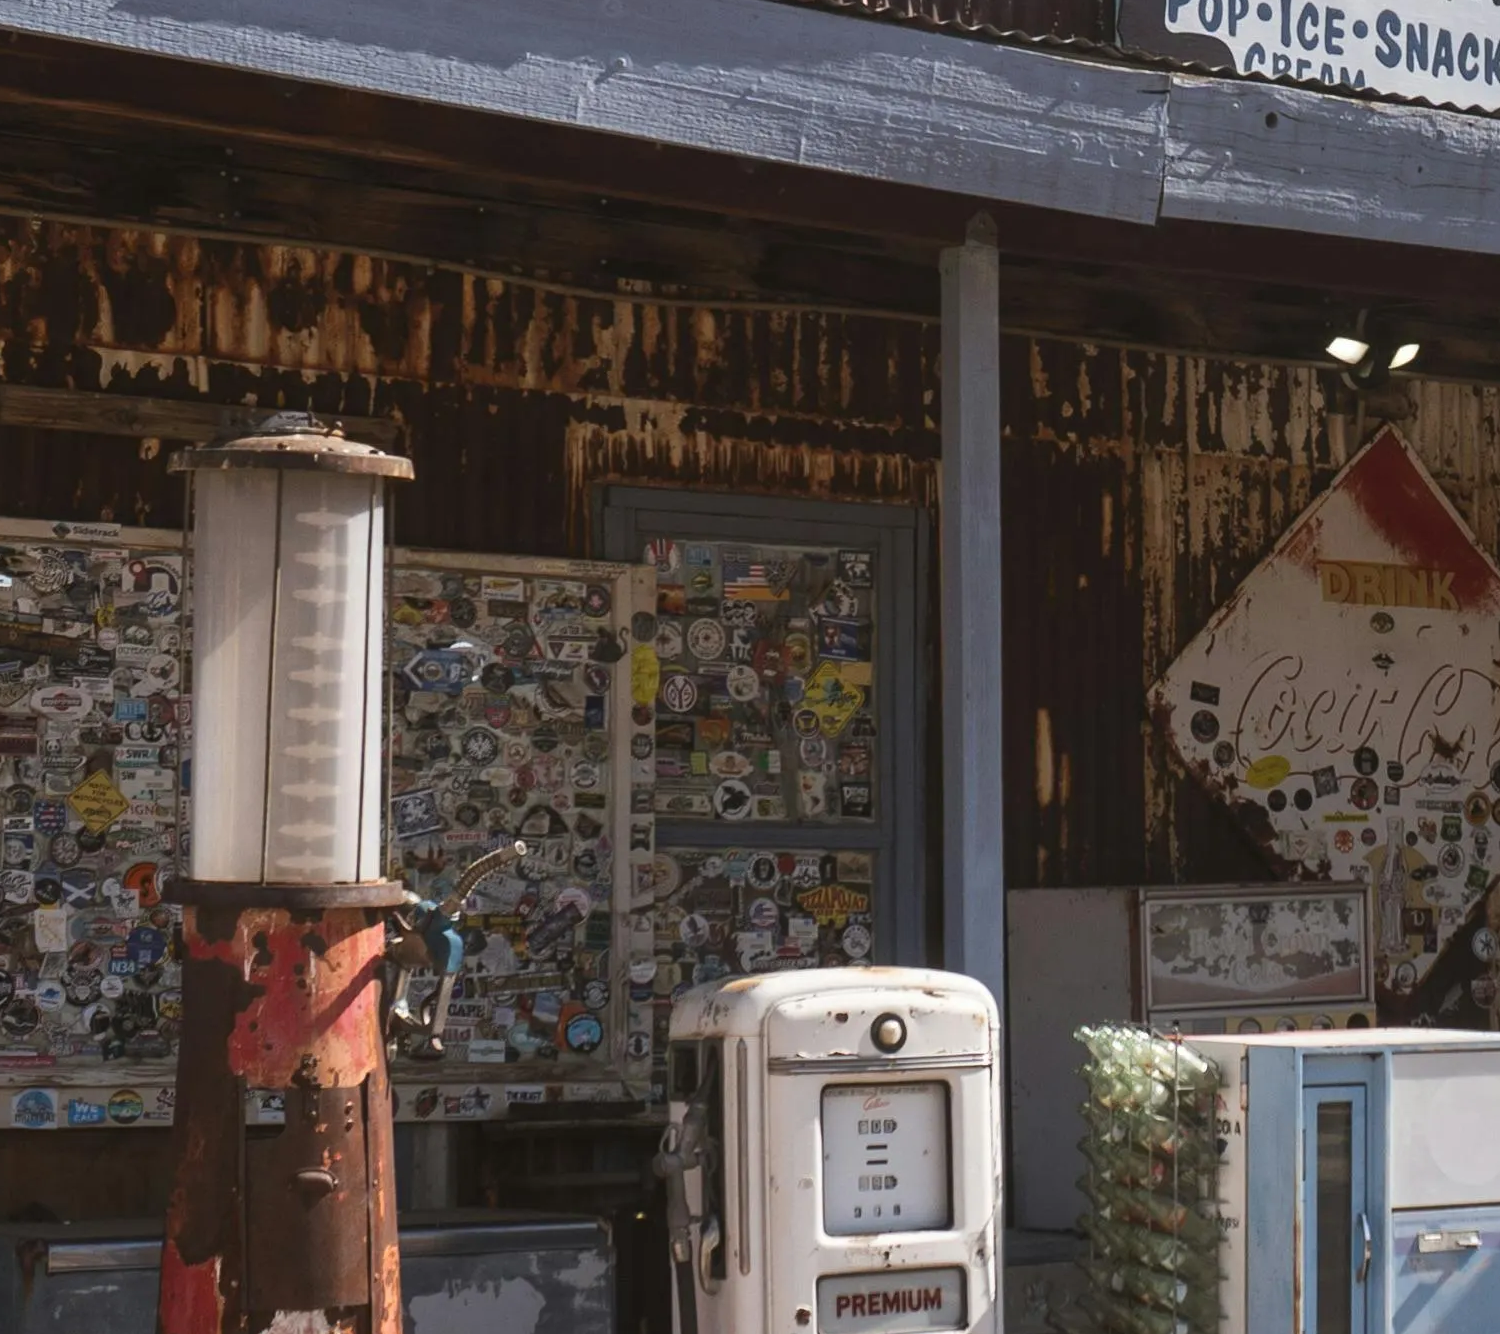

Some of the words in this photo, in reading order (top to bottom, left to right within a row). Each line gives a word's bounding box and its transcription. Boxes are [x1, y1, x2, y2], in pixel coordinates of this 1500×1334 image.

[1323, 564, 1461, 610] DRINK
[1216, 1118, 1241, 1136] COA
[836, 1286, 942, 1317] PREMIUM
